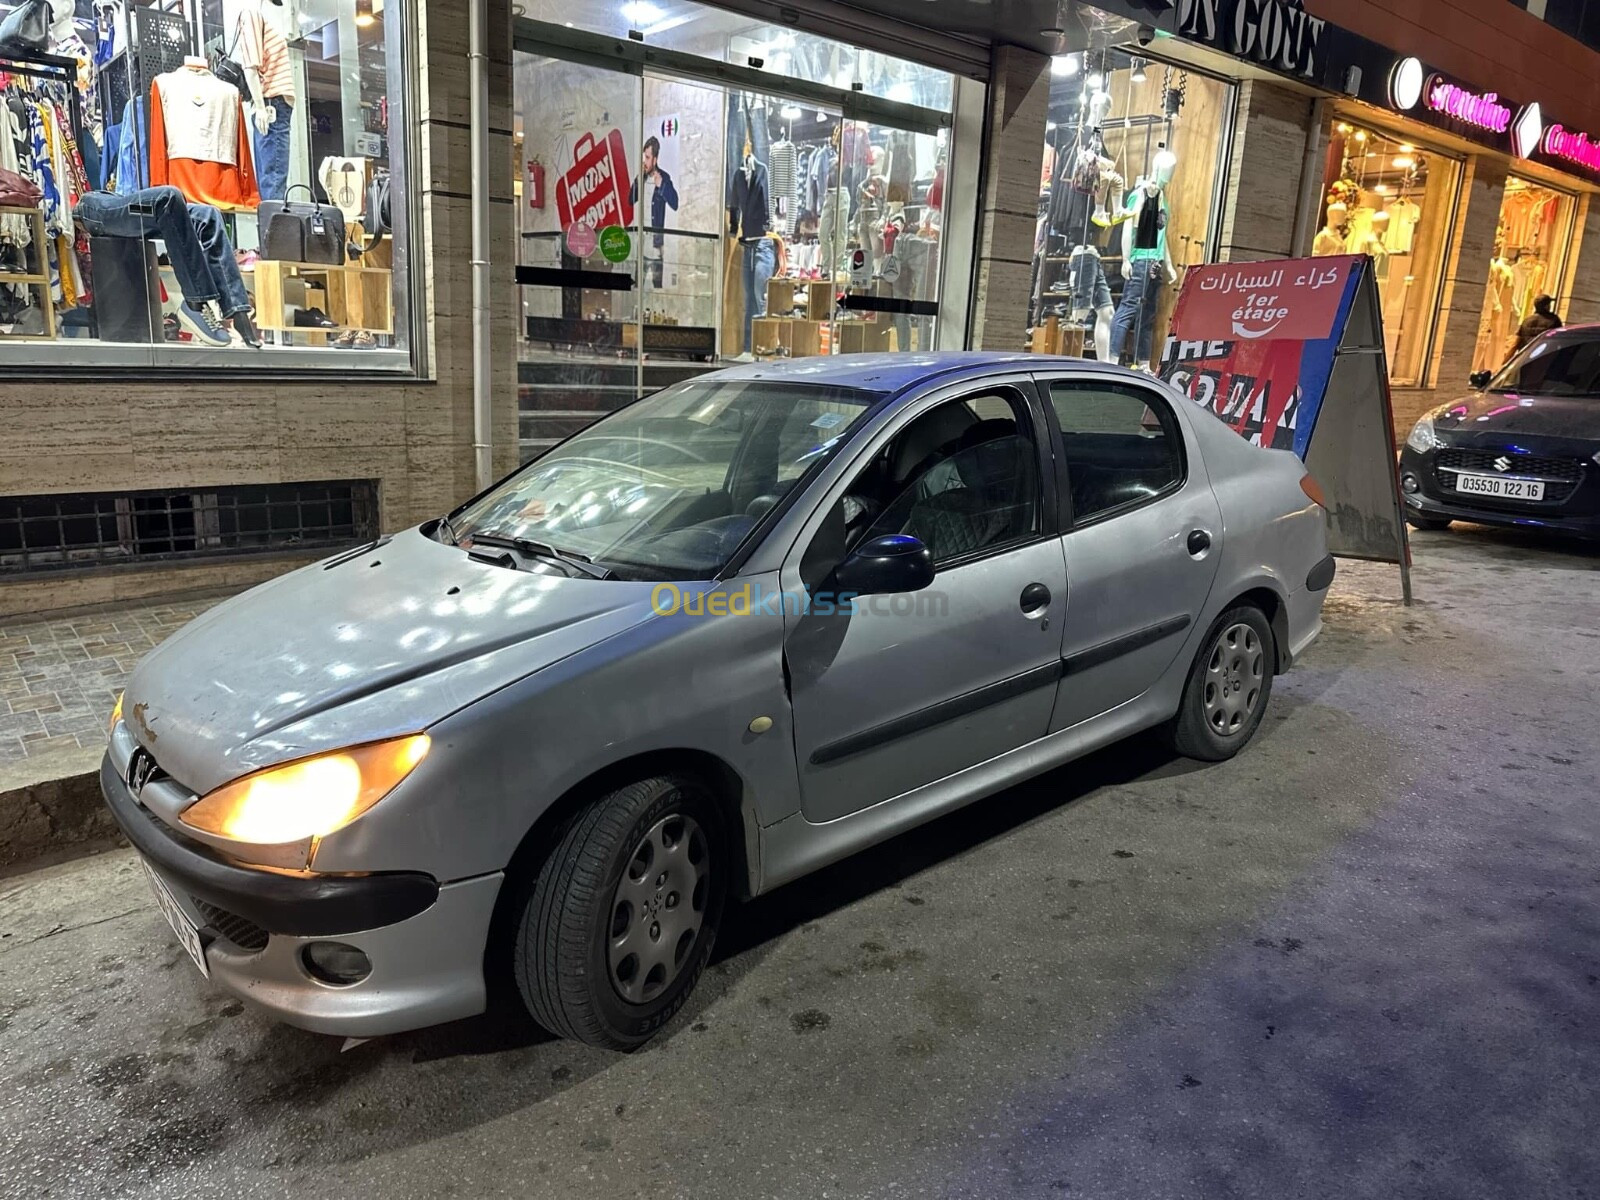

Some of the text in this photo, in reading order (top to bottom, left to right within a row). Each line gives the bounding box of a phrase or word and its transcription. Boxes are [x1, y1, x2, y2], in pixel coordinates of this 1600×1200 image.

[569, 154, 611, 207] MON
[578, 190, 615, 230] OUT
[1200, 267, 1337, 293] كراء السيارات
[1246, 293, 1278, 307] 1er
[1231, 306, 1288, 322] étage
[1462, 477, 1539, 497] 035530 122 16
